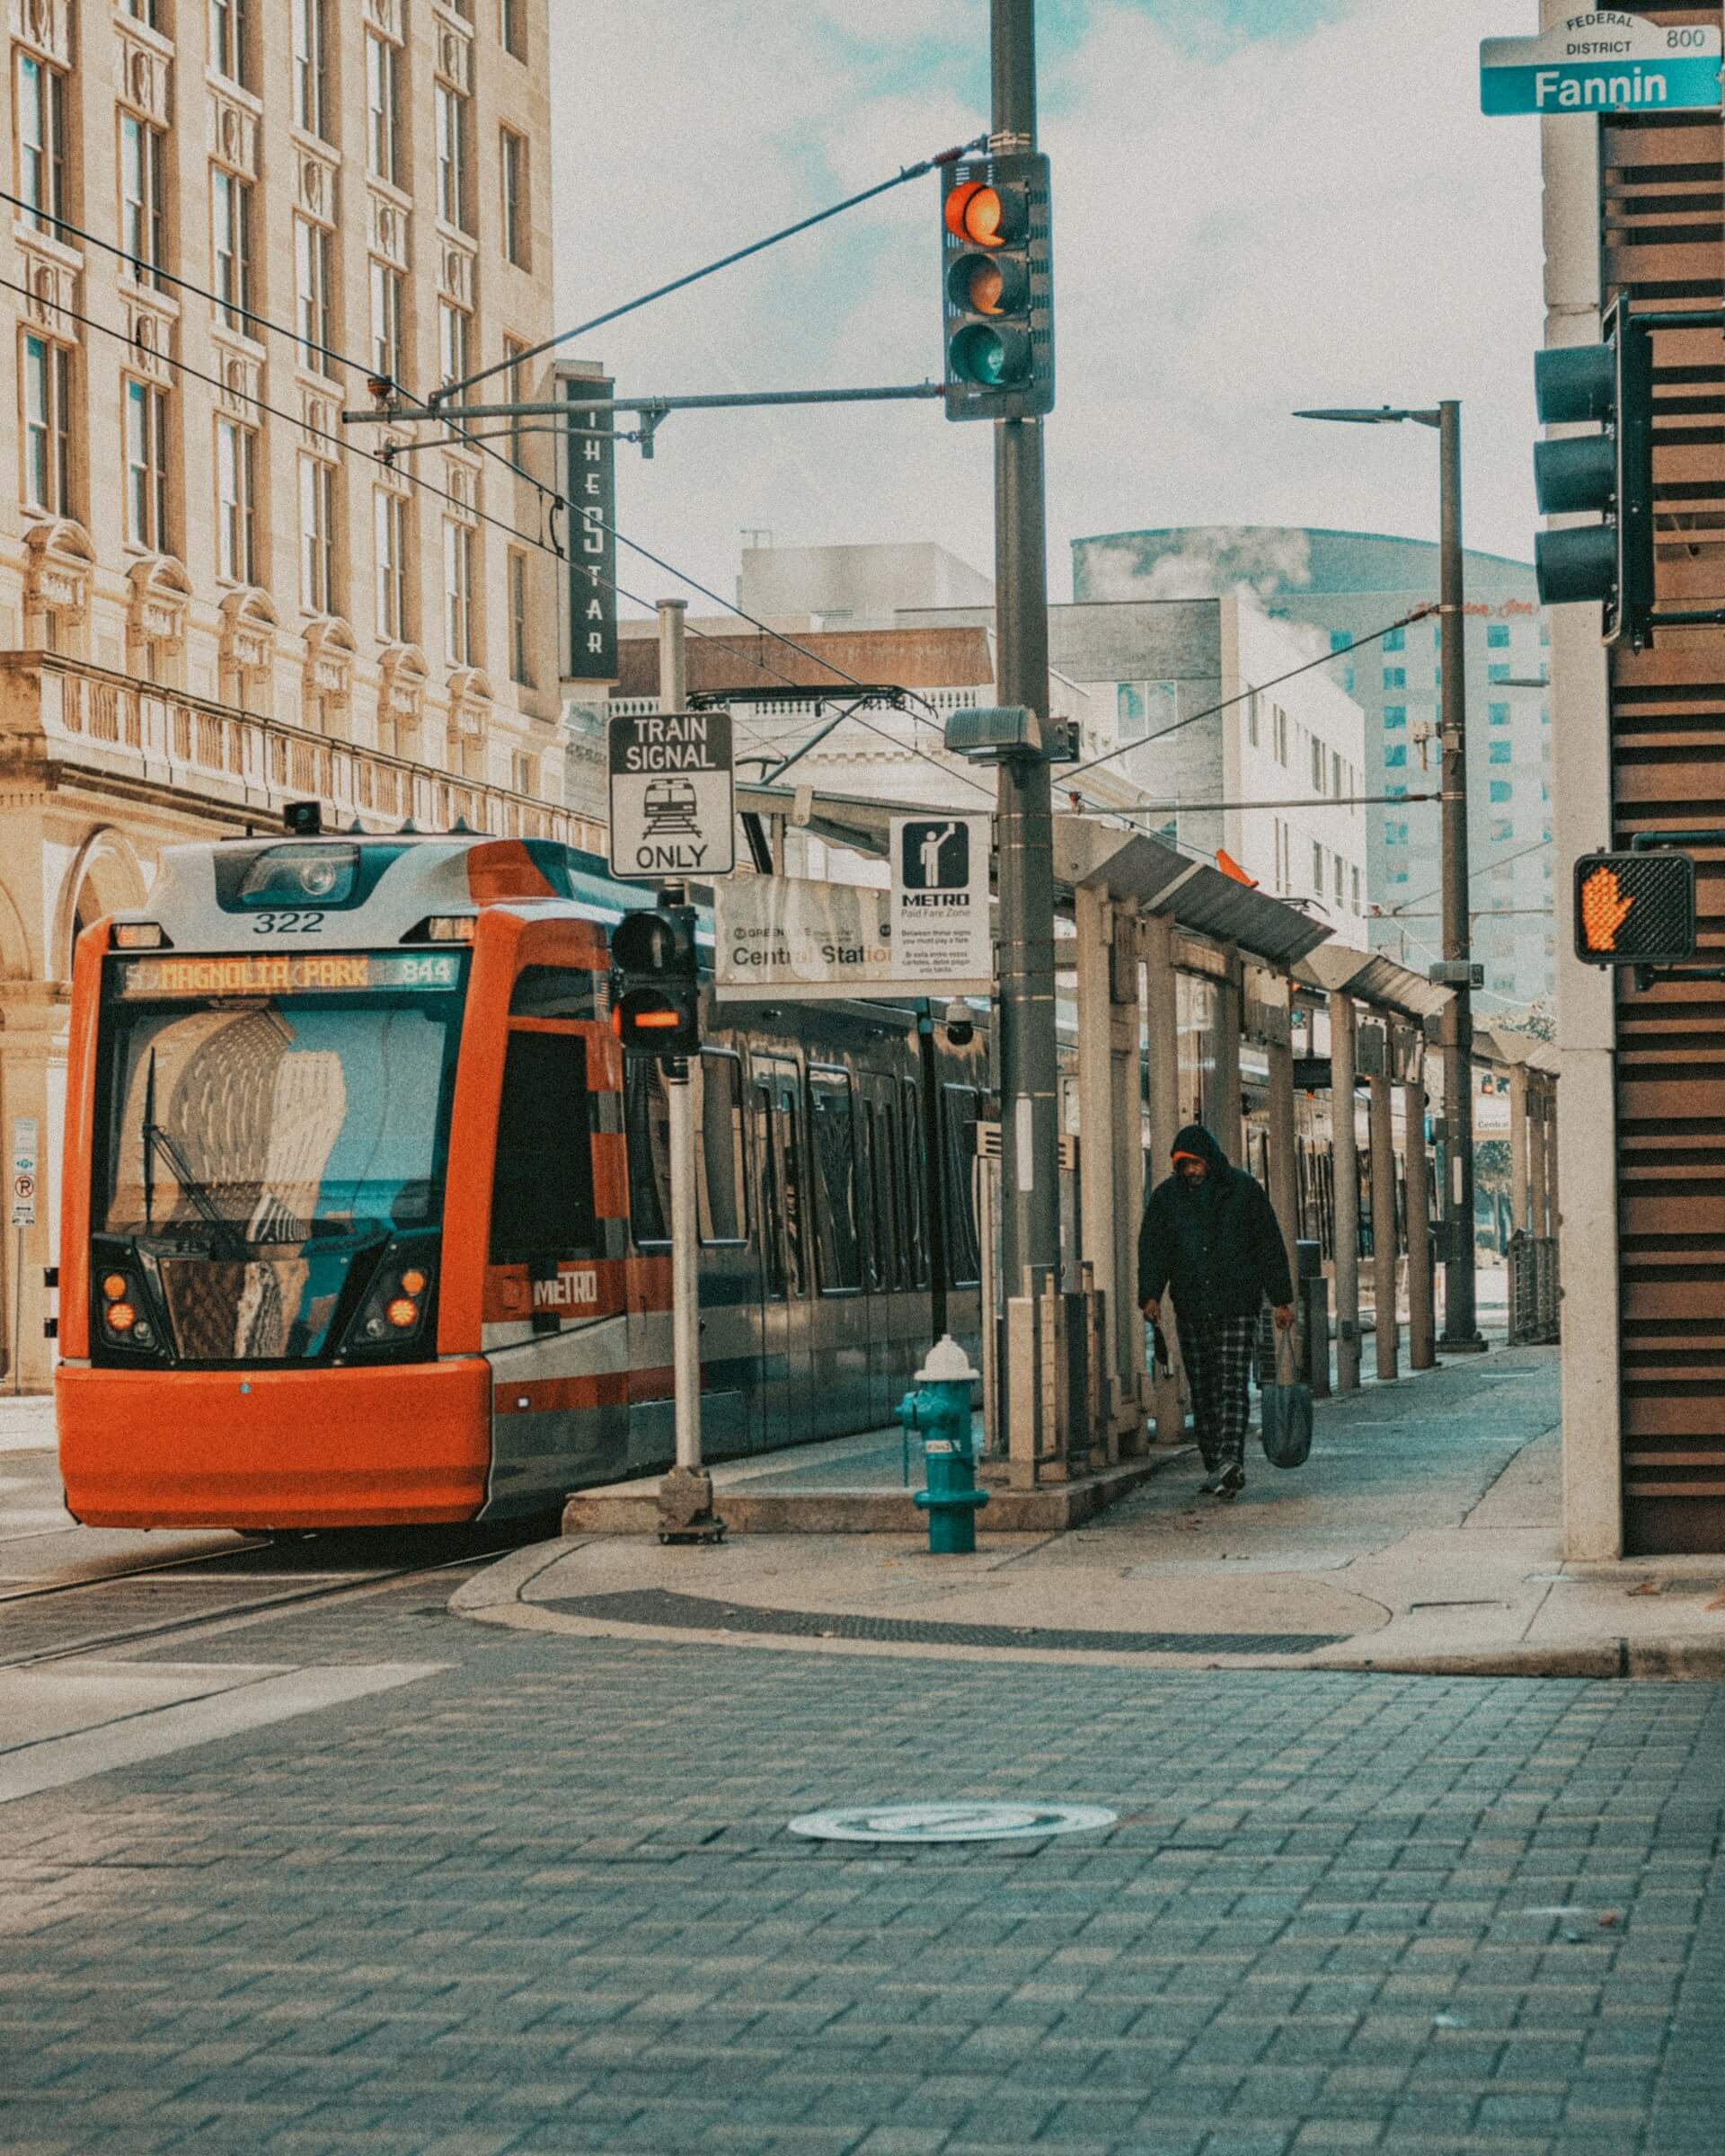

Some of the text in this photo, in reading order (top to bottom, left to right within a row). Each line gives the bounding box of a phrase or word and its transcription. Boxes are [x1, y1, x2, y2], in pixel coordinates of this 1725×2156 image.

[1566, 13, 1634, 31] FEDERAL
[1566, 40, 1632, 56] DISTRICT
[1667, 29, 1705, 48] 800
[1535, 66, 1668, 108] Fannin
[583, 506, 605, 654] STAR
[633, 718, 708, 743] TRAIN
[626, 744, 717, 770] SIGNAL
[636, 844, 708, 869] ONLY
[902, 893, 969, 907] METRO
[252, 912, 325, 934] 322
[901, 908, 922, 918] Paid
[748, 928, 784, 938] GREEN
[160, 960, 288, 990] MAGNOLIA
[304, 958, 368, 987] PARK
[534, 1269, 597, 1306] METRO
